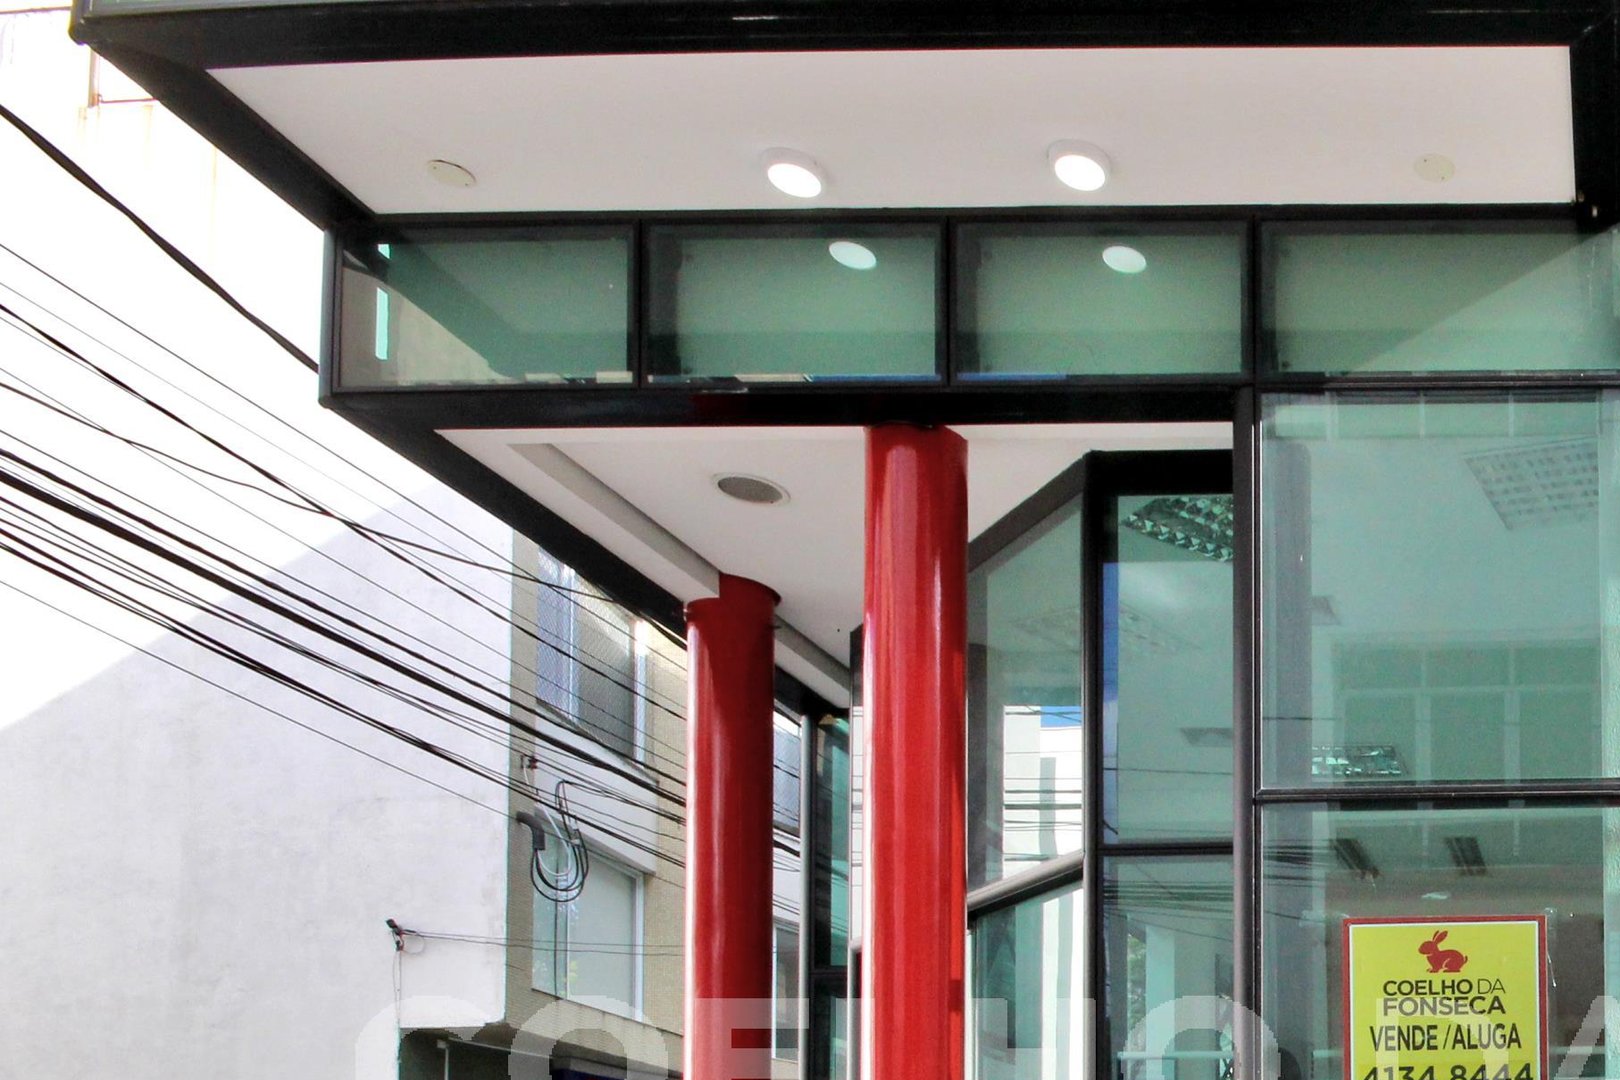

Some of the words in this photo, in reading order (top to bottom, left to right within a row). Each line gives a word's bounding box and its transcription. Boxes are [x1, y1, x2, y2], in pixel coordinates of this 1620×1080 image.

[1383, 979, 1473, 996] COELHO
[1477, 979, 1506, 995] DA
[1383, 996, 1506, 1017] FONSECA
[1370, 1025, 1438, 1052] VENDE
